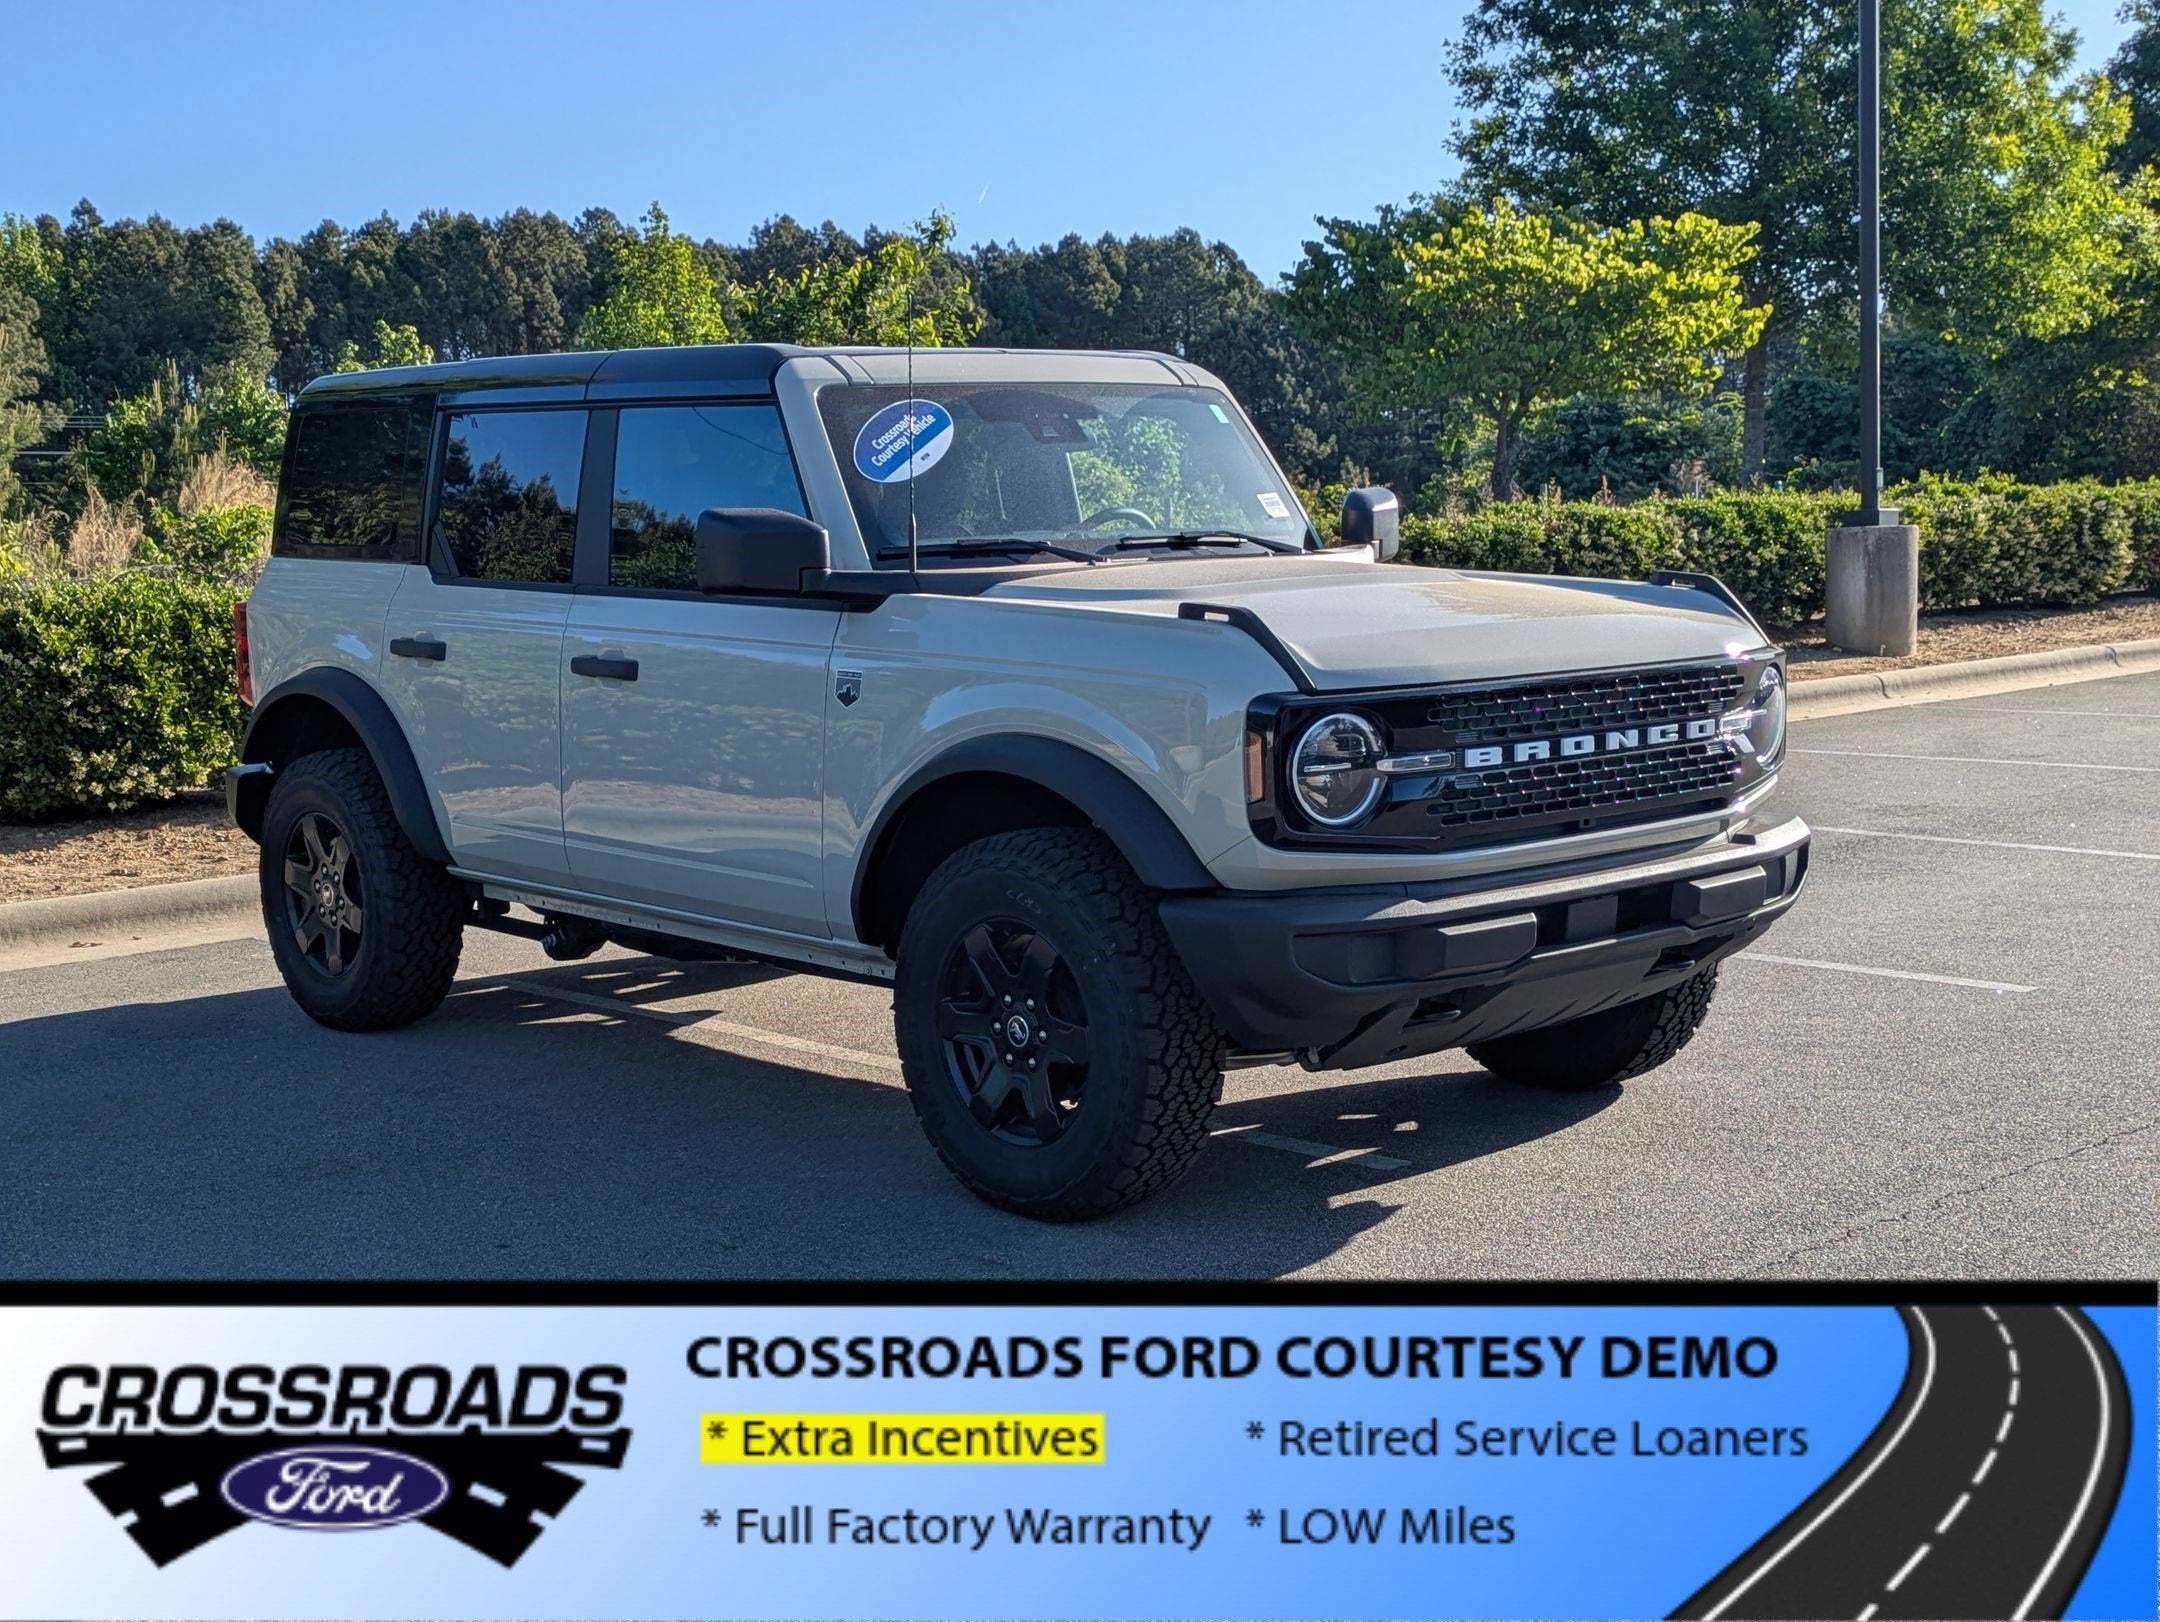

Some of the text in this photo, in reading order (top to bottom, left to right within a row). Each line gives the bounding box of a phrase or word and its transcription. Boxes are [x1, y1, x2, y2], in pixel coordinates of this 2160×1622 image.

[871, 414, 917, 450] Crossroads
[871, 413, 937, 467] Courtesy Vehicle
[1463, 718, 1716, 769] BRONCO
